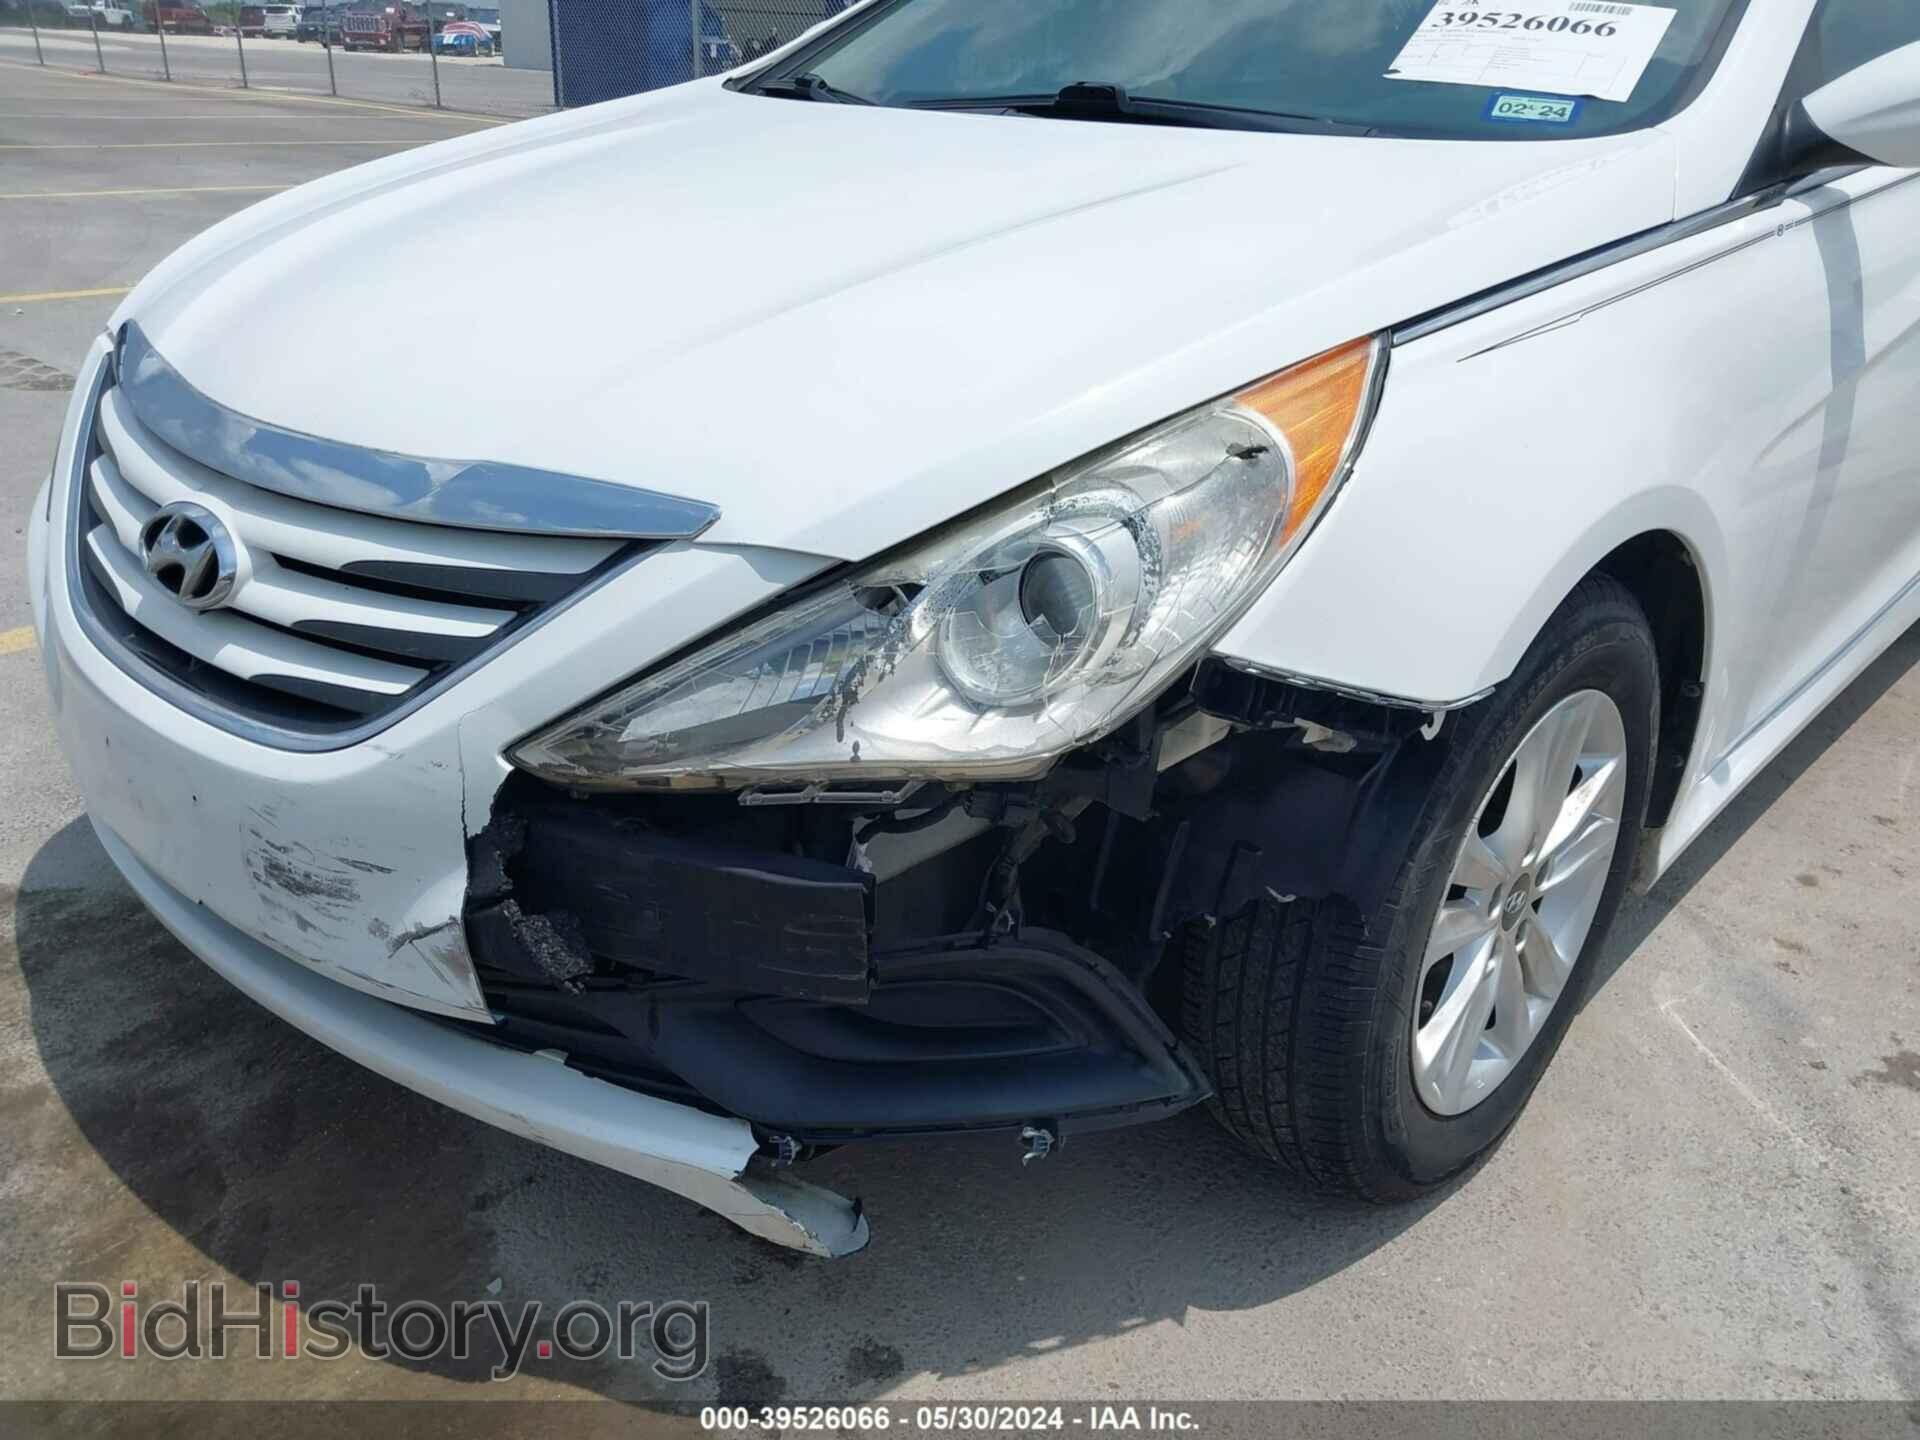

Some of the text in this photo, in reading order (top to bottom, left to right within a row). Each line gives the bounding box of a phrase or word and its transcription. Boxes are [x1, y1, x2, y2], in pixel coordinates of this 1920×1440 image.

[1432, 11, 1616, 36] 39526066
[1498, 102, 1567, 118] 02 24
